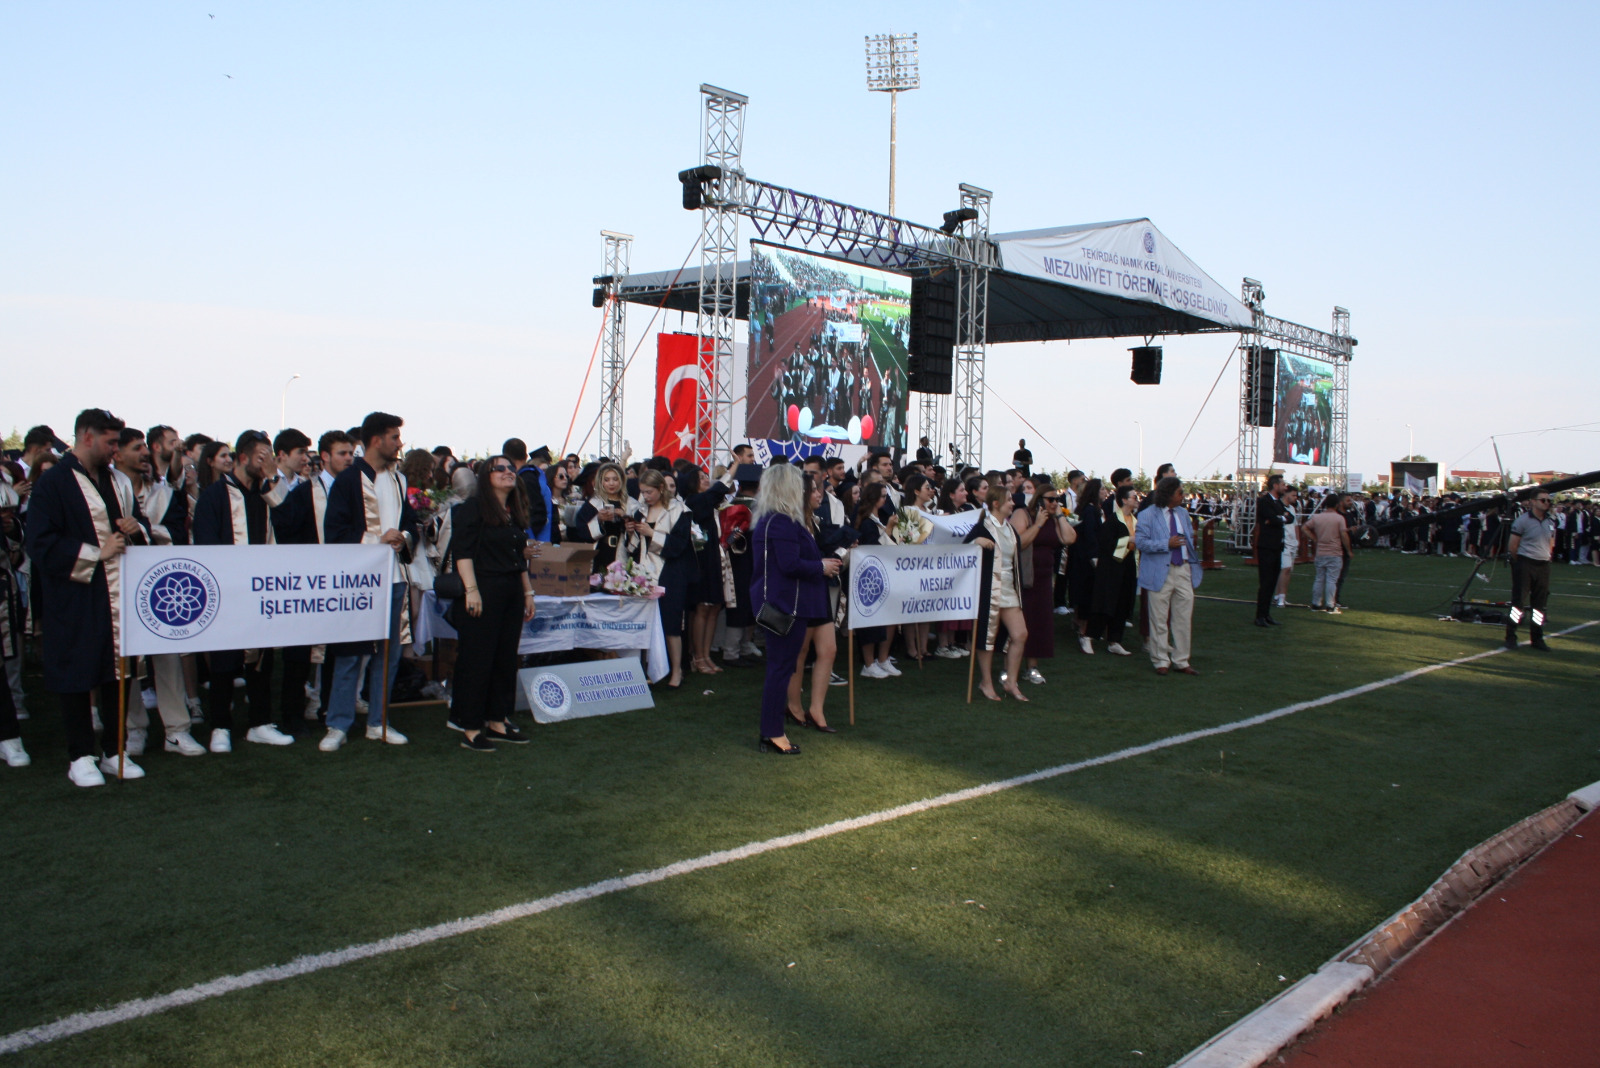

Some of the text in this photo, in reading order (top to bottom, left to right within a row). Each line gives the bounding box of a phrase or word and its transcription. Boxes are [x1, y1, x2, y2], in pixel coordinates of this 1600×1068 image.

[1081, 247, 1119, 265] TEKİRDAĞ
[1120, 256, 1143, 270] NAMIK
[1043, 256, 1112, 285] MEZUNİYET
[895, 553, 978, 571] SOSYAL BİLİMLER
[251, 570, 382, 592] DENİZ VE LİMAN
[920, 577, 956, 592] MESLEK
[140, 562, 217, 631] TEKİRDAĞ NAMIK KEMAL ÜNİVERSİTESİ
[260, 592, 373, 619] İŞLETMECİLİĞİ
[901, 596, 972, 614] YÜKSEKOKULU
[169, 628, 190, 637] 2006
[579, 673, 604, 687] SOSYAL
[575, 683, 647, 702] MESLEK YÜKSEKOKULU
